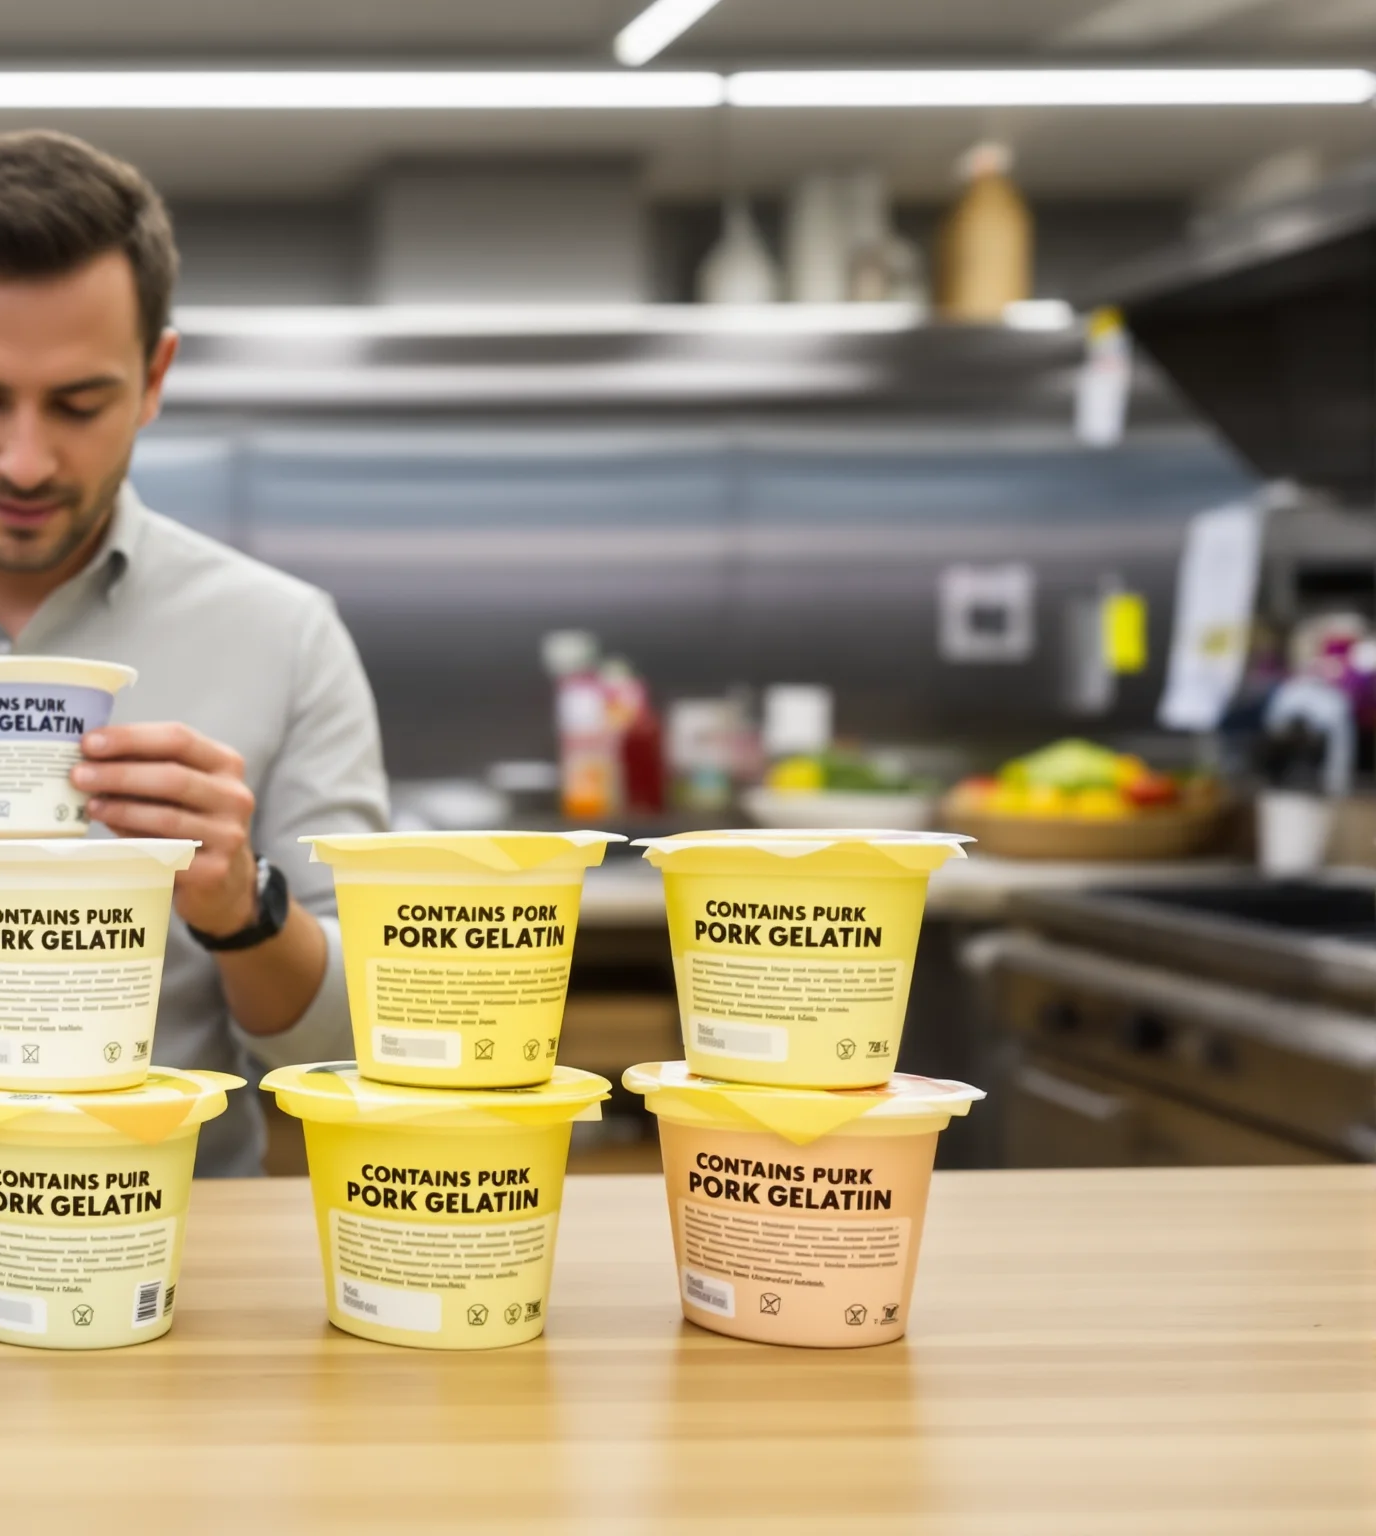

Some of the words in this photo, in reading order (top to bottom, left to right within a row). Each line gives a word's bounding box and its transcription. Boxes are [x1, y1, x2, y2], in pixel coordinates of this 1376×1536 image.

[397, 905, 505, 922] CONTAINS
[513, 905, 557, 921] PORK
[706, 900, 806, 921] CONTAINS
[41, 927, 145, 950] GELATIN
[384, 925, 458, 948] PORK
[465, 925, 565, 949] GELATIN
[695, 920, 761, 945] PORK
[769, 926, 882, 947] GELATIN
[361, 1164, 471, 1187] CONTAINS
[696, 1152, 805, 1182] CONTAINS
[348, 1181, 418, 1211] PORK
[689, 1171, 761, 1204] PORK
[51, 1189, 162, 1217] GELATIN
